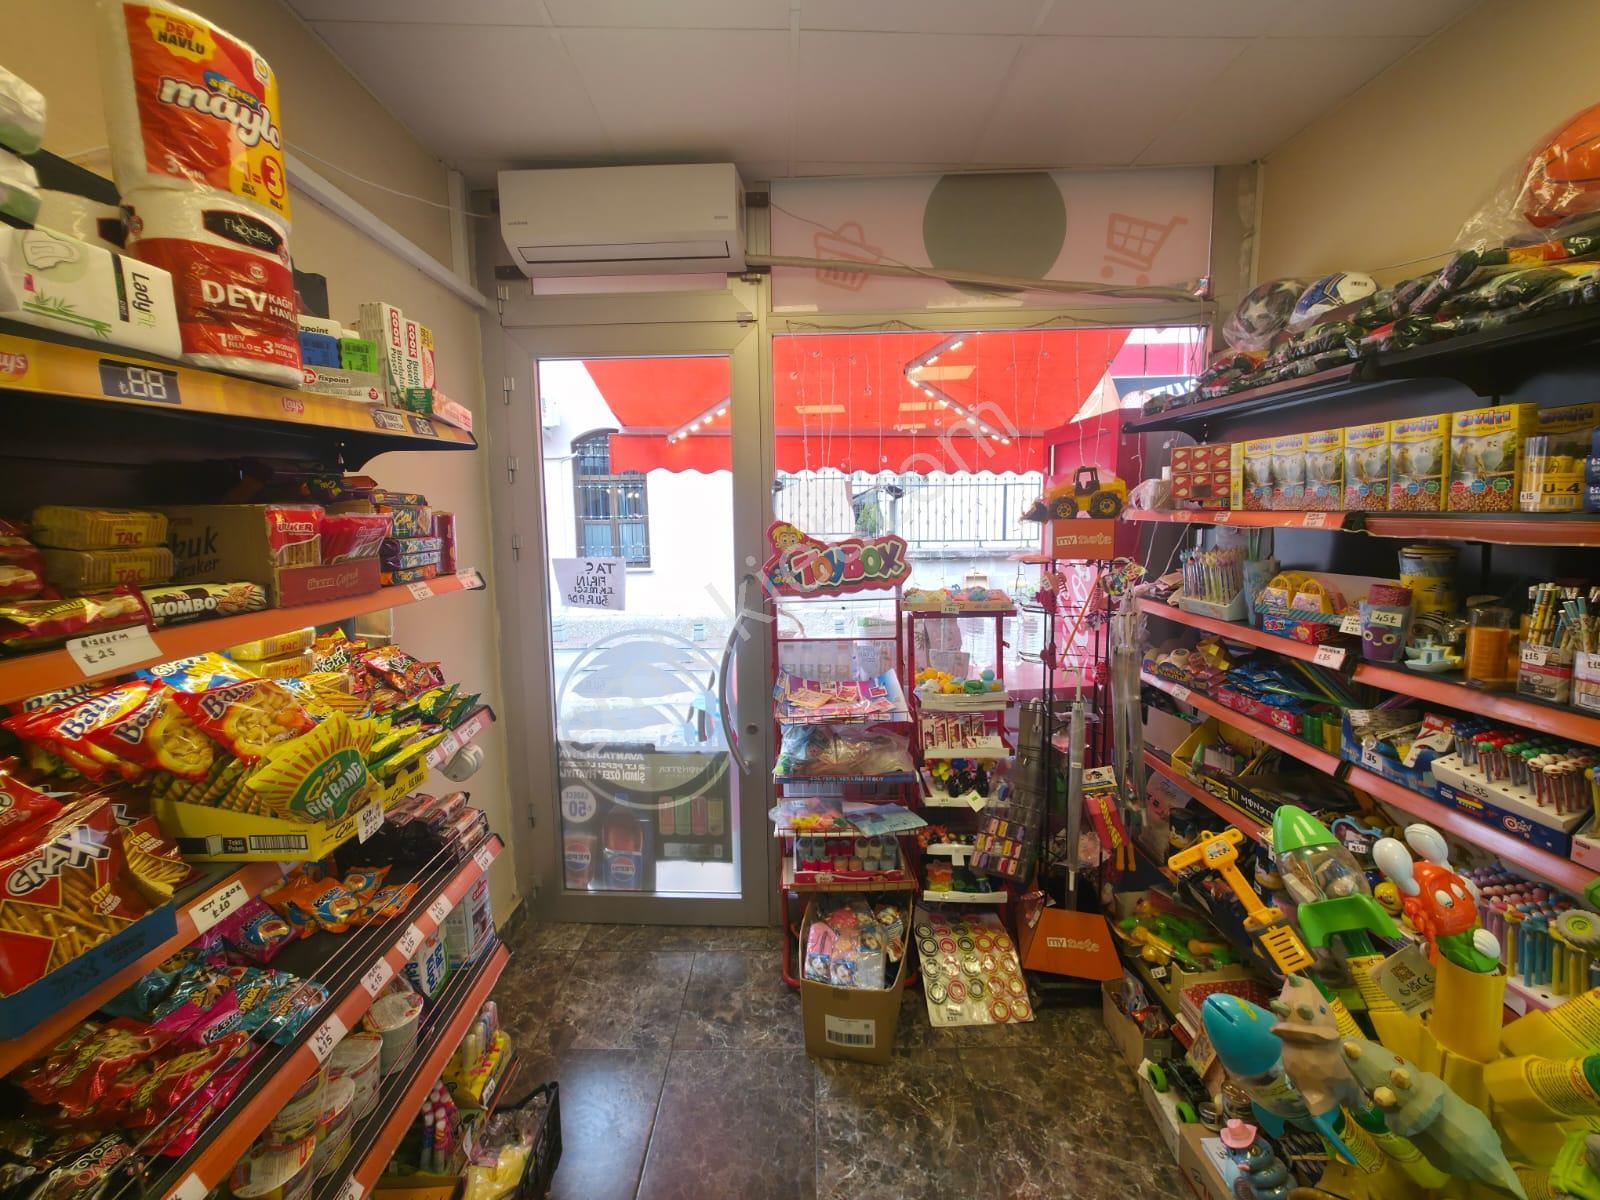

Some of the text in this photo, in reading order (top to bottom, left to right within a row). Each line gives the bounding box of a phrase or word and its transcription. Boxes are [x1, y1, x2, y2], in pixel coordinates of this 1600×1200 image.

[164, 20, 195, 40] DEV
[158, 32, 205, 55] HAVLU
[200, 279, 268, 313] DEV
[390, 310, 400, 347] COOK
[263, 340, 275, 355] 3
[407, 323, 417, 358] COOK
[317, 375, 350, 385] fixpoint
[1542, 481, 1582, 494] U-4
[151, 597, 217, 618] KOMBO
[306, 791, 333, 815] BIG
[329, 761, 362, 799] BANG
[5, 824, 111, 897] CRAX
